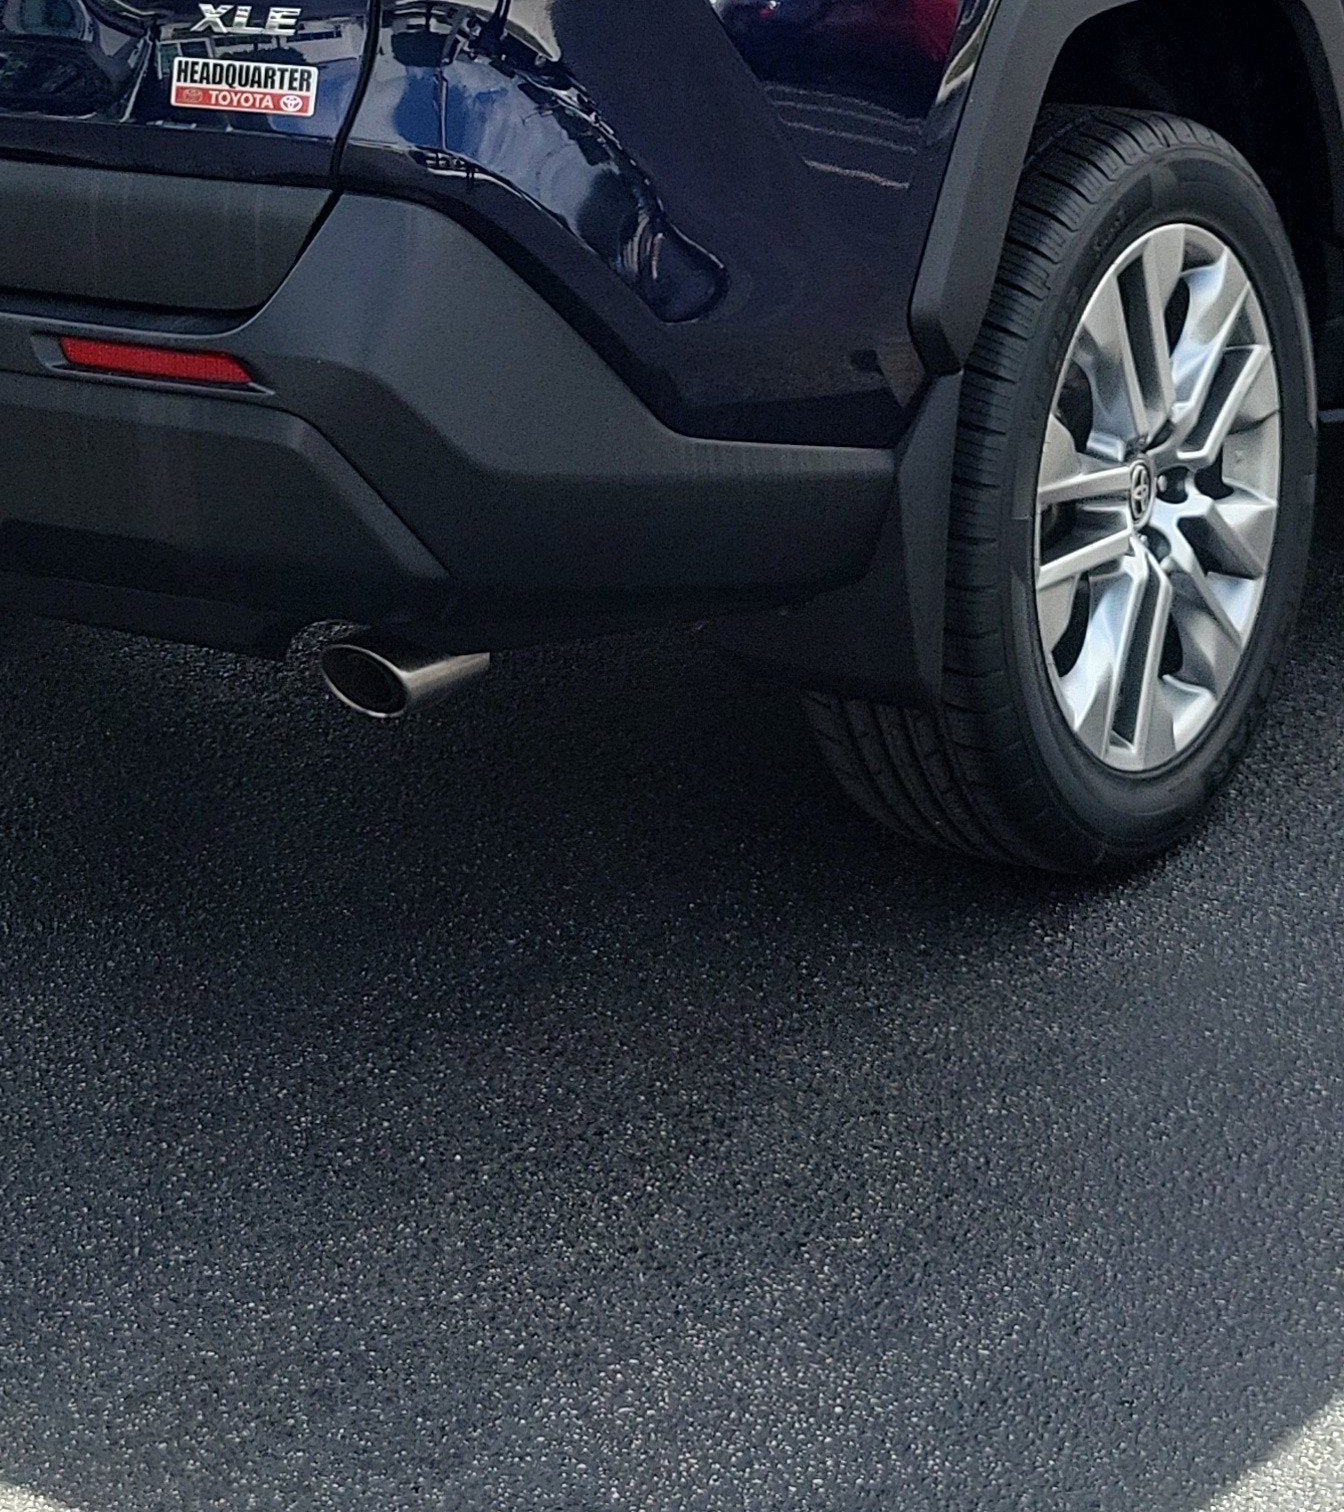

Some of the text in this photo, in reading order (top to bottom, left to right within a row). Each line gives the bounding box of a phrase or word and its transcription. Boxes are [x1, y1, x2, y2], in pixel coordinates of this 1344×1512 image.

[190, 3, 302, 36] XLE
[176, 59, 312, 92] HEADQUARTER
[208, 90, 274, 109] TOYOTA
